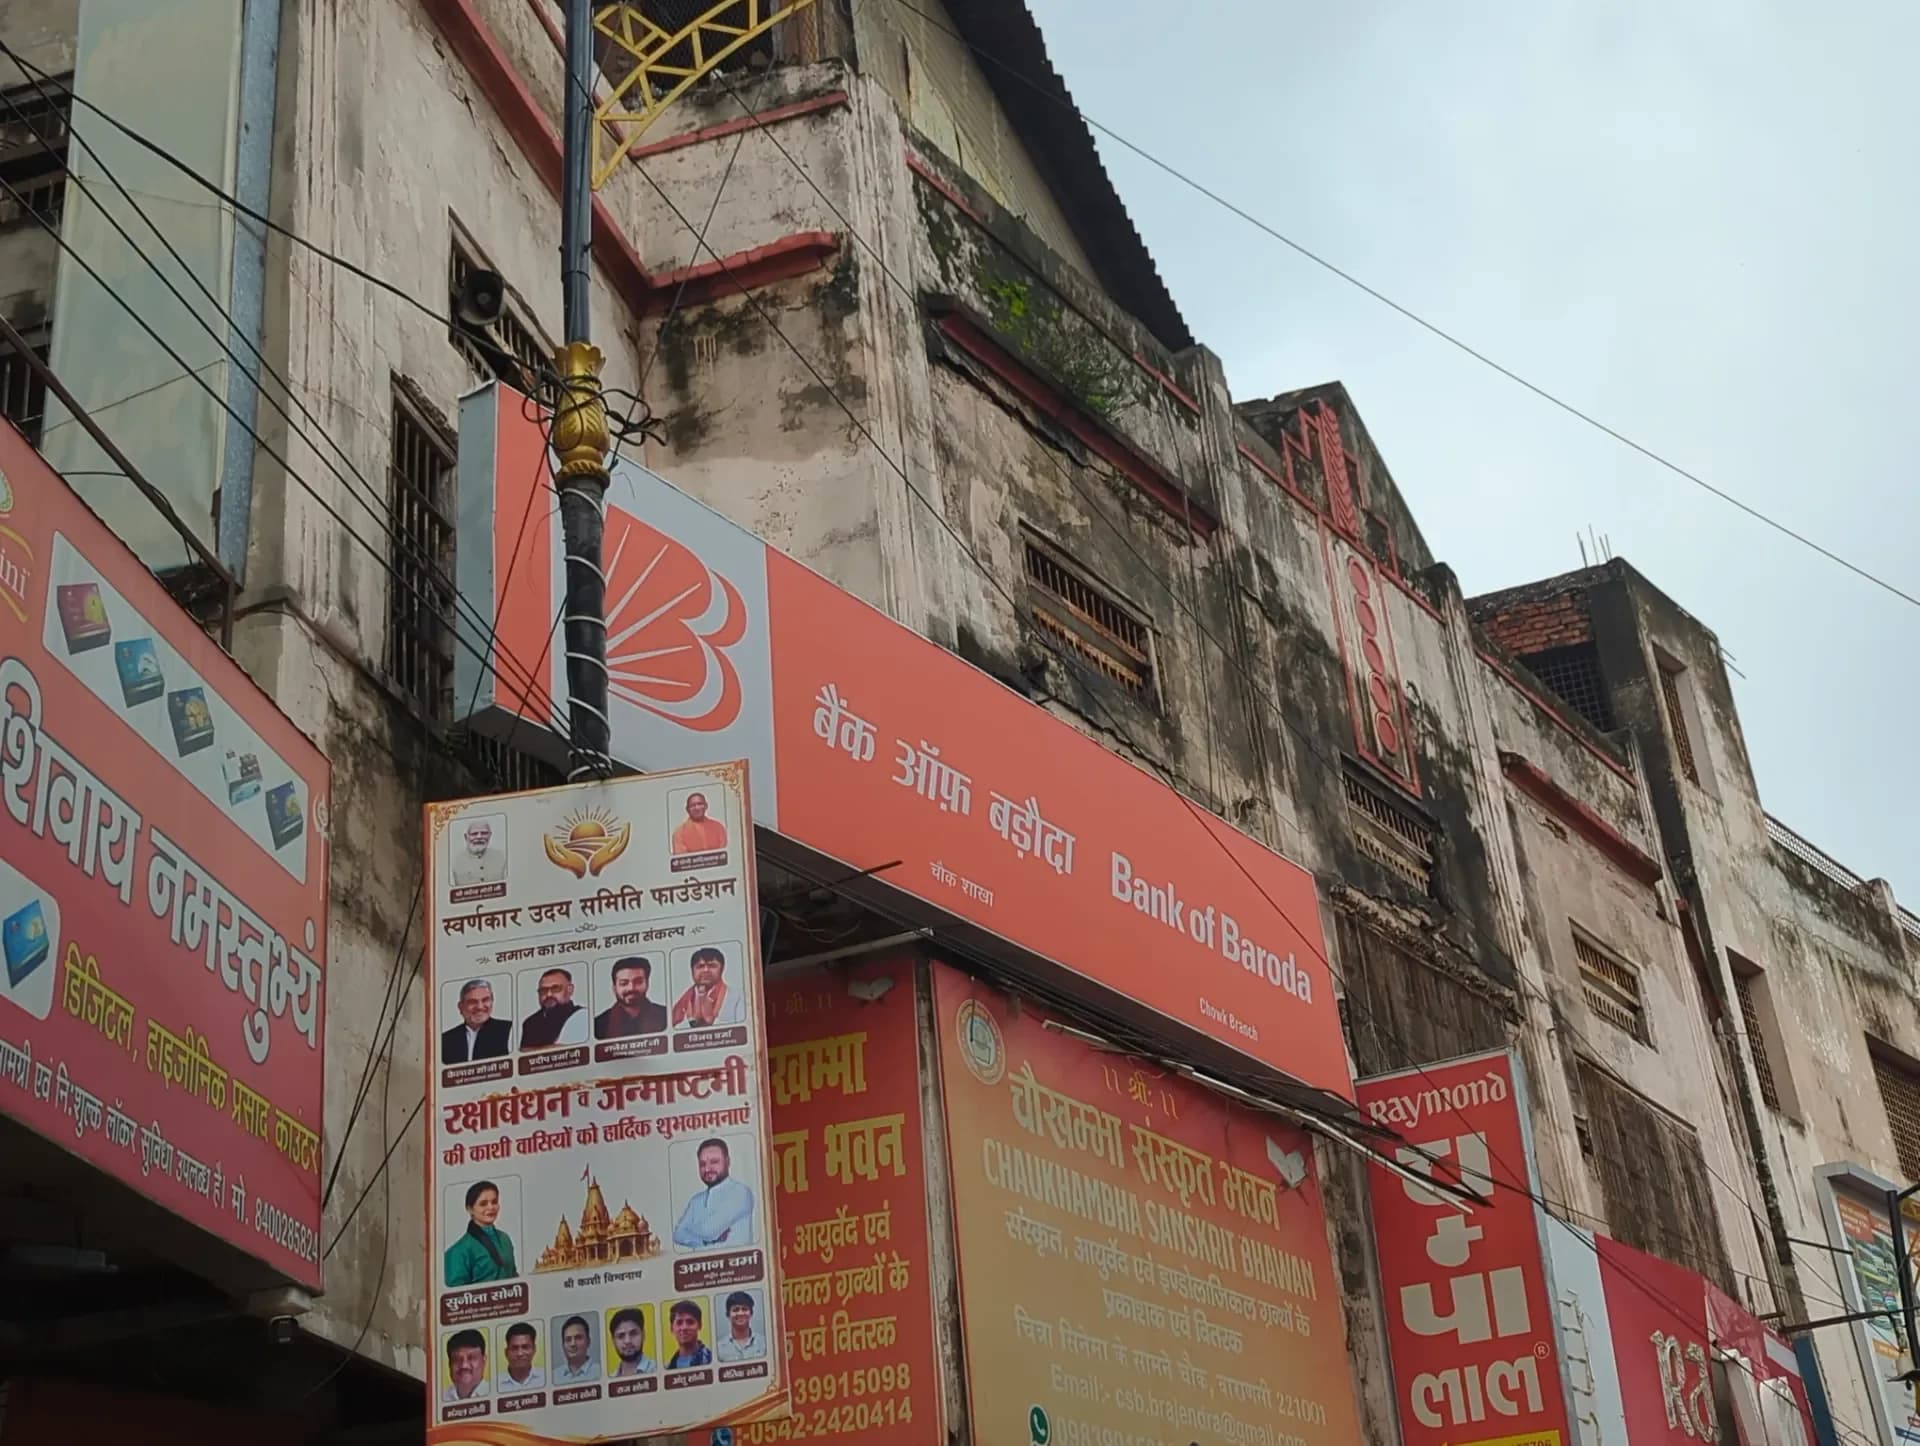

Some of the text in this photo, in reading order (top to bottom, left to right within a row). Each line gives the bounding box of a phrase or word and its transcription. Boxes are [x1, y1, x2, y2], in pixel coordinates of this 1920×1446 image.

[813, 684, 877, 761] बैंक
[989, 790, 1076, 875] बड़ौदा
[442, 876, 737, 937] स्वर्णकार उदय समिति फाउंडेशन
[929, 860, 993, 907] चौक शाखा
[149, 827, 322, 1064] नमस्तुभ्यं
[495, 948, 535, 964] समाज
[538, 944, 556, 958] का
[604, 933, 640, 950] हमारा
[643, 925, 686, 942] संकल्प
[1111, 851, 1312, 1004] Bank of Baroda
[1199, 997, 1259, 1042] Chowk Branch
[34, 1057, 53, 1102] एवं
[106, 1097, 138, 1153] लॉकर
[141, 1120, 174, 1177] सुविधा
[147, 1018, 227, 1112] हाइजीनिक
[231, 1079, 270, 1142] प्रसाद
[275, 1107, 320, 1175] काउंटर
[443, 1085, 572, 1135] रक्षाबंधन
[597, 1054, 749, 1112] जन्माष्टमी
[443, 1142, 465, 1167] की
[469, 1135, 511, 1162] काशी
[516, 1126, 573, 1155] वासियों
[576, 1122, 598, 1145] को
[602, 1115, 651, 1143] हार्दिक
[824, 1113, 906, 1185] भवन
[1129, 1115, 1216, 1208] संस्कृत
[1219, 1160, 1281, 1232] भवन
[863, 1199, 890, 1246] एवं
[983, 1137, 1317, 1301] CHAUKHAMBHA SANSKRIT BHAWAN
[446, 1292, 487, 1311] सुनीता
[491, 1285, 522, 1301] सोनी
[888, 1250, 910, 1291] के
[800, 1314, 826, 1361] एवं
[831, 1309, 897, 1355] वितरक
[1168, 1304, 1192, 1340] एवं
[1193, 1307, 1244, 1354] वितरक
[794, 1362, 912, 1405] 39915098
